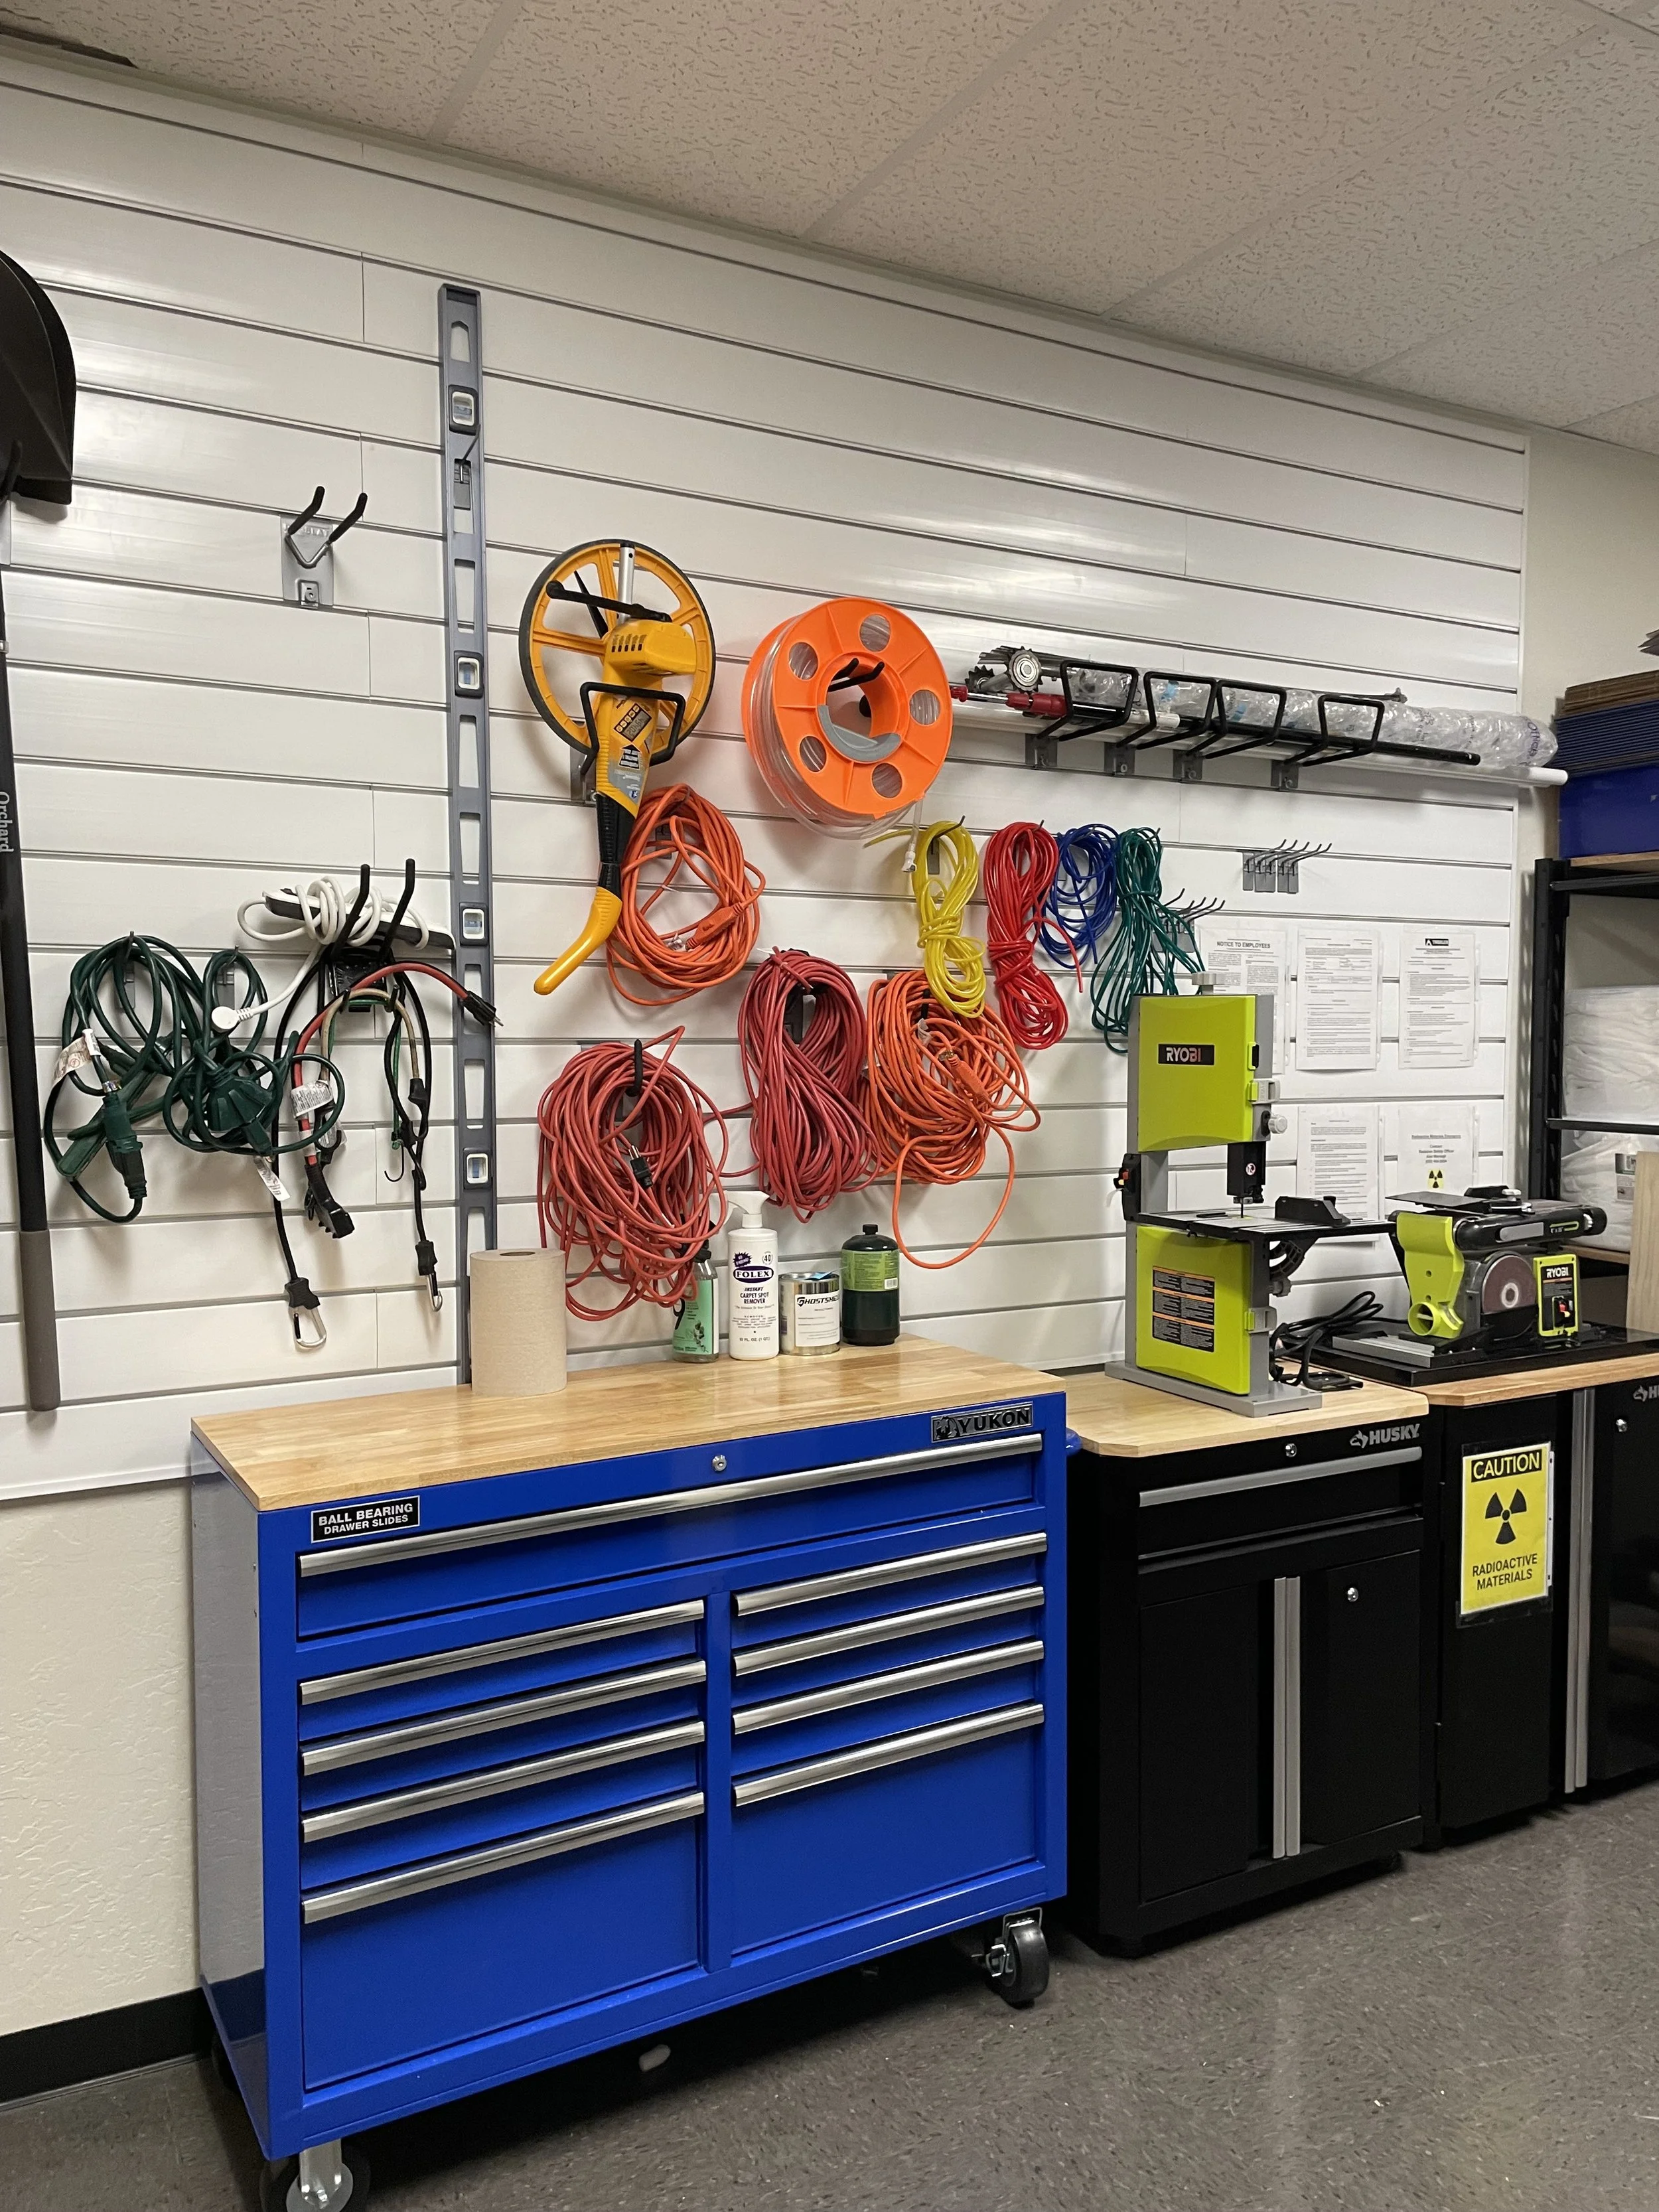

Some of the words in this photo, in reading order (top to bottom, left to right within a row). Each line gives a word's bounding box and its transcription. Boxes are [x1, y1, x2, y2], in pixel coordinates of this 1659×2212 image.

[0, 791, 14, 852] Orchard
[1166, 1047, 1201, 1062] RYOBI
[1546, 1267, 1569, 1278] RYOBI
[1649, 1385, 1659, 1399] H
[958, 1408, 1030, 1434] YUKON
[1369, 1424, 1420, 1445] HUSKY
[1473, 1452, 1540, 1479] CAUTION
[319, 1513, 352, 1526] BALL
[356, 1503, 413, 1520] BEARING
[324, 1520, 369, 1535] DRAWER
[372, 1514, 408, 1527] SLIDES
[1472, 1553, 1538, 1577] RADIOACTIVE
[1477, 1568, 1532, 1591] MATERIALS
